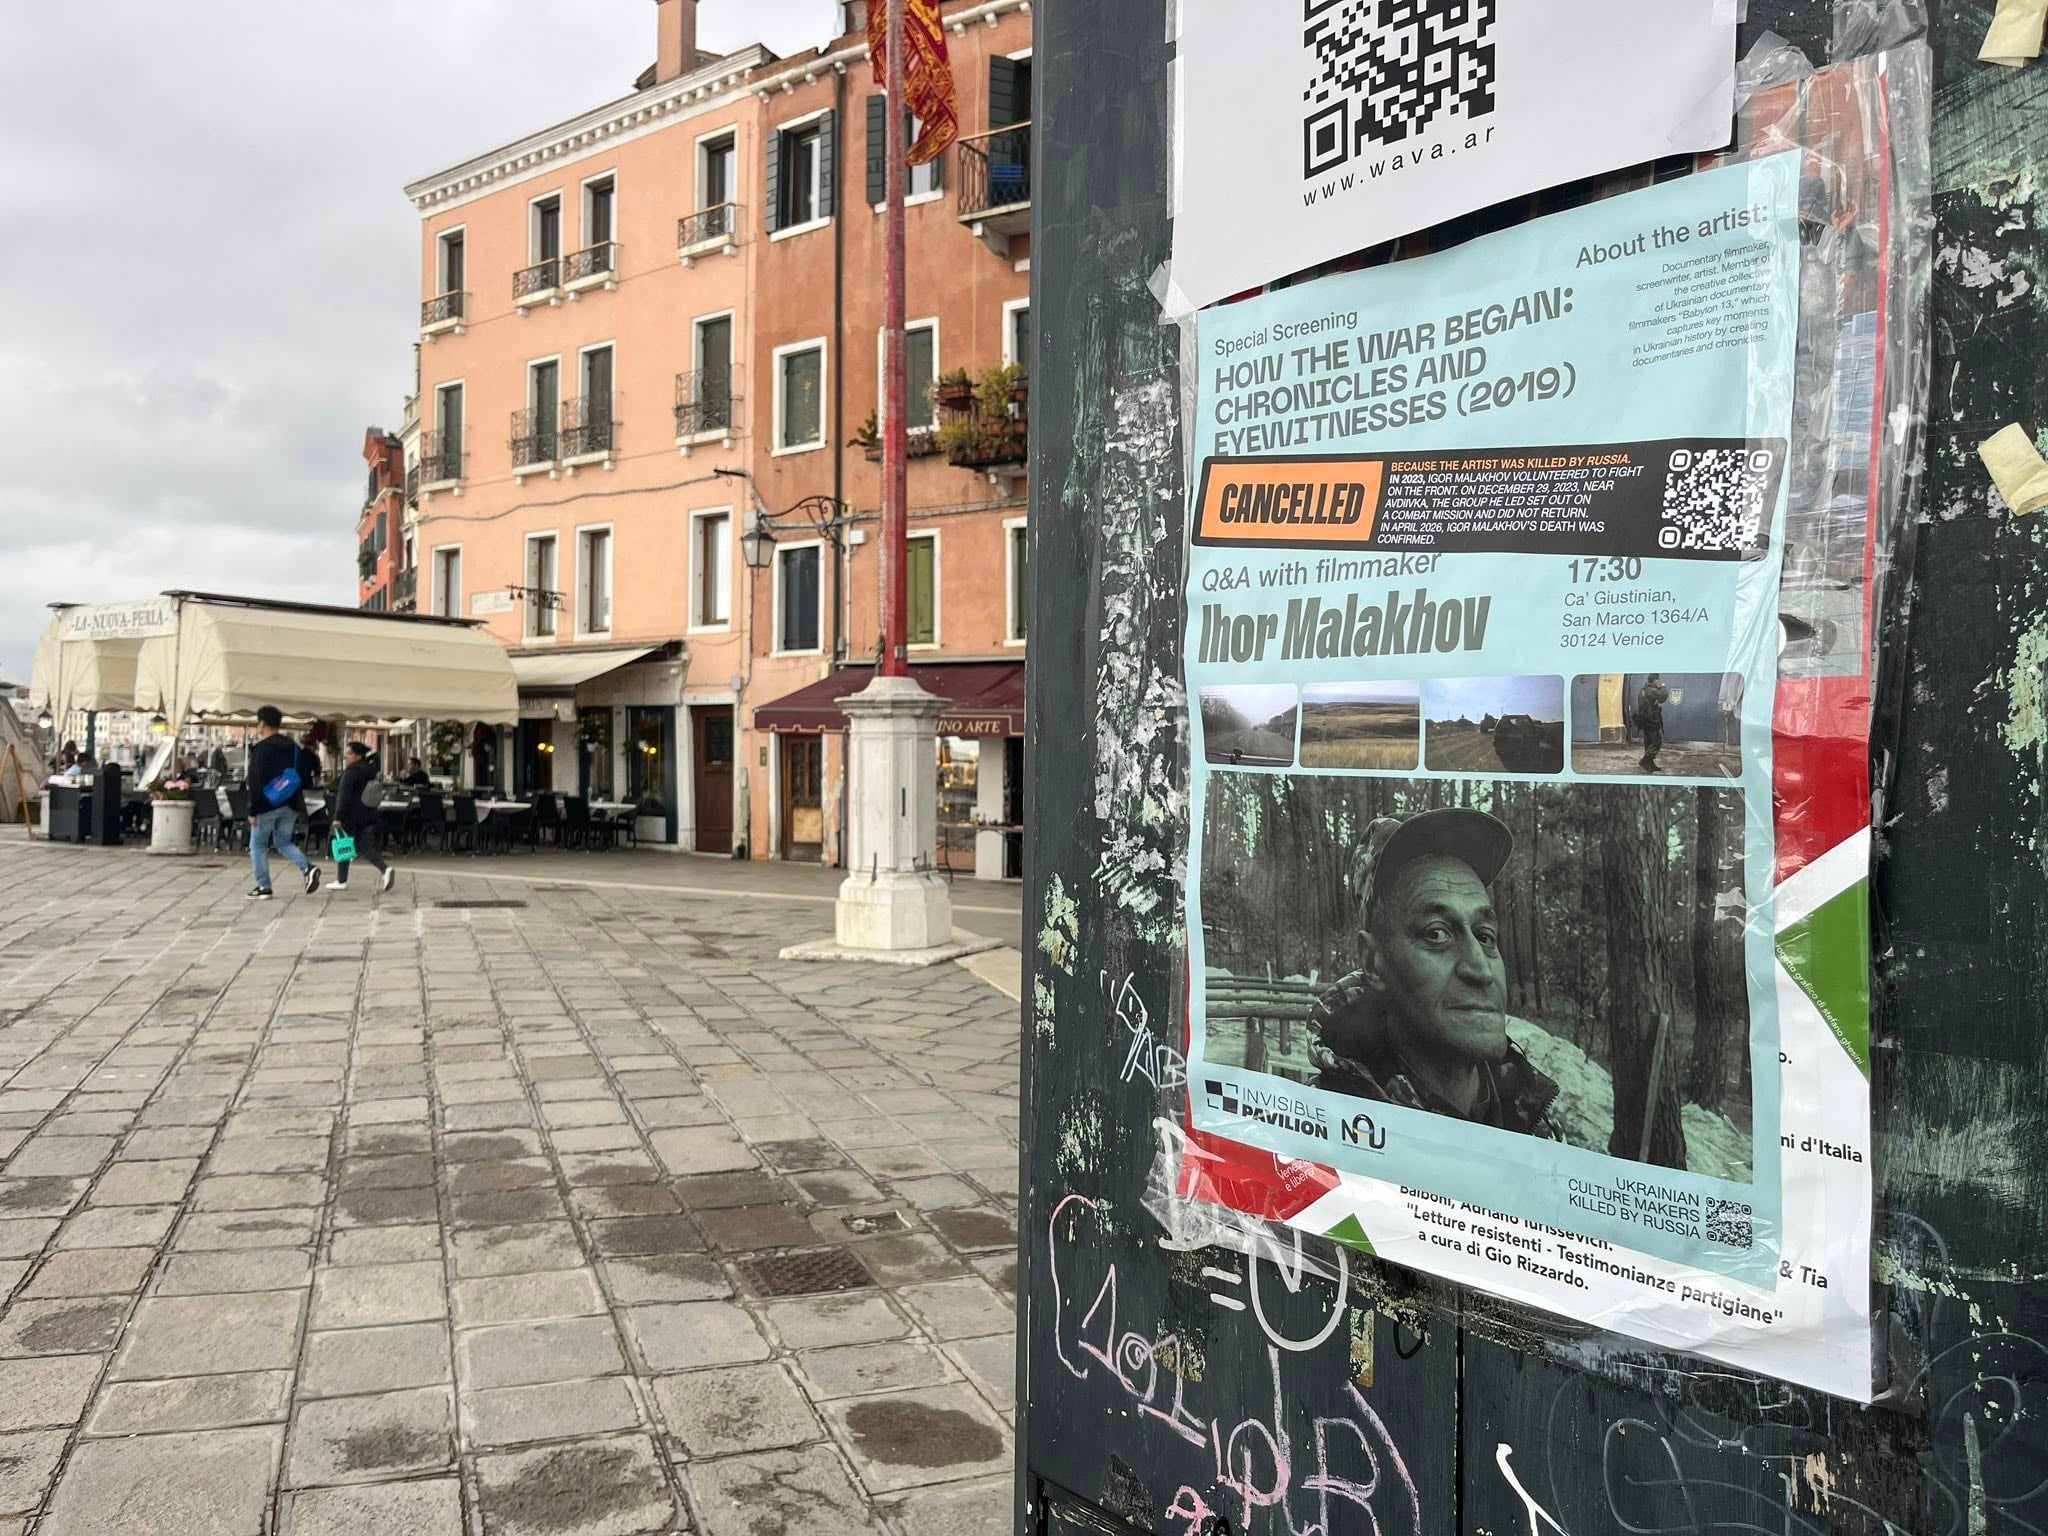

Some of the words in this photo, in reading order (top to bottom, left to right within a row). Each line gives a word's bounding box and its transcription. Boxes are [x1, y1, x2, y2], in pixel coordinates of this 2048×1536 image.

[1303, 126, 1495, 206] www.wava.ar
[1576, 232, 1646, 269] About
[1652, 225, 1690, 249] the
[1697, 203, 1768, 238] artist:
[1635, 273, 1692, 292] screenwriter,
[1694, 266, 1719, 281] artist.
[1720, 257, 1758, 273] Member
[1760, 253, 1771, 264] of
[1661, 250, 1722, 274] Documentary
[1722, 240, 1770, 260] filmmaker,
[1654, 302, 1666, 313] of
[1666, 294, 1708, 312] Ukrainian
[1709, 281, 1771, 301] documentary
[1674, 286, 1689, 296] the
[1690, 278, 1727, 292] creative
[1728, 268, 1771, 284] collective
[1628, 313, 1676, 331] filmmakers
[1740, 294, 1771, 306] which
[1666, 320, 1704, 336] captures
[1705, 314, 1722, 328] key
[1723, 306, 1770, 322] moments
[1214, 327, 1268, 358] Special
[1272, 311, 1358, 342] Screening
[1215, 353, 1284, 394] HOW
[1291, 339, 1350, 377] THE
[1356, 322, 1436, 364] WAR
[1444, 286, 1574, 347] BEGAN:
[1632, 346, 1641, 355] in
[1642, 337, 1684, 353] Ukrainian
[1684, 330, 1713, 346] history
[1714, 324, 1728, 337] by
[1728, 320, 1769, 335] creating
[1632, 346, 1695, 368] documentaries
[1695, 337, 1714, 352] and
[1714, 332, 1767, 349] chronicles.
[1214, 364, 1408, 425] CHRONICLES
[1414, 346, 1487, 388] AND
[1214, 390, 1447, 456] EYEWITNESSES
[1456, 360, 1576, 417] (2019)
[1389, 474, 1400, 484] IN
[1400, 474, 1426, 485] 2023,
[1428, 472, 1453, 484] IGOR
[1454, 471, 1512, 484] MALAKHOV
[1512, 468, 1590, 482] VOLUNTEERED
[1592, 467, 1608, 478] TO
[1608, 466, 1645, 478] FIGHT
[1390, 460, 1437, 472] BECAUSE
[1439, 460, 1460, 470] THE
[1461, 459, 1500, 470] ARTIST
[1501, 458, 1525, 469] WAS
[1526, 456, 1566, 468] KILLED
[1568, 456, 1586, 467] BY
[1586, 454, 1631, 466] RUSSIA.
[1218, 482, 1366, 525] CANCELLED
[1384, 498, 1429, 509] AVDIIVKA,
[1432, 498, 1452, 508] THE
[1451, 497, 1488, 508] GROUP
[1488, 496, 1504, 507] HE
[1504, 496, 1525, 506] LED
[1526, 494, 1548, 506] SET
[1548, 494, 1573, 506] OUT
[1574, 494, 1592, 505] ON
[1387, 486, 1402, 496] ON
[1404, 486, 1424, 496] THE
[1424, 485, 1458, 496] FRONT.
[1460, 484, 1477, 496] ON
[1478, 484, 1535, 496] DECEMBER
[1536, 482, 1550, 494] 29,
[1552, 482, 1580, 494] 2023,
[1582, 480, 1615, 492] NEAR
[1380, 522, 1391, 532] IN
[1390, 522, 1418, 532] APRIL
[1420, 522, 1444, 534] 2026,
[1446, 522, 1472, 533] IGOR
[1540, 521, 1576, 532] DEATH
[1578, 522, 1605, 532] WAS
[1382, 510, 1390, 520] A
[1390, 510, 1433, 521] COMBAT
[1432, 510, 1474, 520] MISSION
[1474, 509, 1496, 520] AND
[1496, 509, 1517, 519] DID
[1516, 508, 1542, 518] NOT
[1540, 507, 1590, 518] RETURN.
[1377, 534, 1436, 545] CONFIRMED.
[1202, 566, 1251, 592] Q&A
[1258, 562, 1308, 588] with
[1316, 552, 1442, 584] filmmaker
[1568, 556, 1642, 584] 17:30
[1594, 588, 1676, 606] Giustinian,
[92, 611, 128, 630] NUOVA
[132, 608, 164, 628] PERLA
[1198, 602, 1279, 664] Ihor
[1280, 588, 1492, 661] Malakhov
[1562, 612, 1590, 628] San
[1596, 612, 1646, 627] Marco
[1650, 607, 1710, 624] 1364/A
[1560, 633, 1607, 648] 30124
[1612, 632, 1664, 647] Venice
[965, 720, 1002, 734] ARTE
[1793, 972, 1818, 1000] grafico
[1816, 999, 1827, 1008] di
[1822, 1008, 1843, 1037] stefano
[1840, 1036, 1865, 1065] ghesini
[1241, 1103, 1328, 1140] PAVILION
[1242, 1087, 1326, 1123] INVISIBLE
[1800, 1136, 1863, 1164] d'Italia
[1290, 1167, 1316, 1188] libera
[1615, 1176, 1700, 1208] UKRAINIAN
[1568, 1178, 1631, 1207] CULTURE
[1634, 1196, 1700, 1223] MAKERS
[1568, 1194, 1617, 1216] KILLED
[1620, 1209, 1641, 1224] BY
[1643, 1214, 1701, 1240] RUSSIA
[1406, 1202, 1466, 1232] "Letture
[1471, 1223, 1542, 1254] resistenti
[1556, 1244, 1676, 1293] Testimonianze
[1680, 1283, 1784, 1325] partigiane"
[1418, 1230, 1426, 1241] a
[1431, 1233, 1462, 1252] cura
[1466, 1240, 1480, 1257] di
[1485, 1246, 1512, 1266] Gio
[1516, 1254, 1590, 1290] Rizzardo.
[1779, 1260, 1794, 1280] &
[1800, 1266, 1828, 1289] Tia
